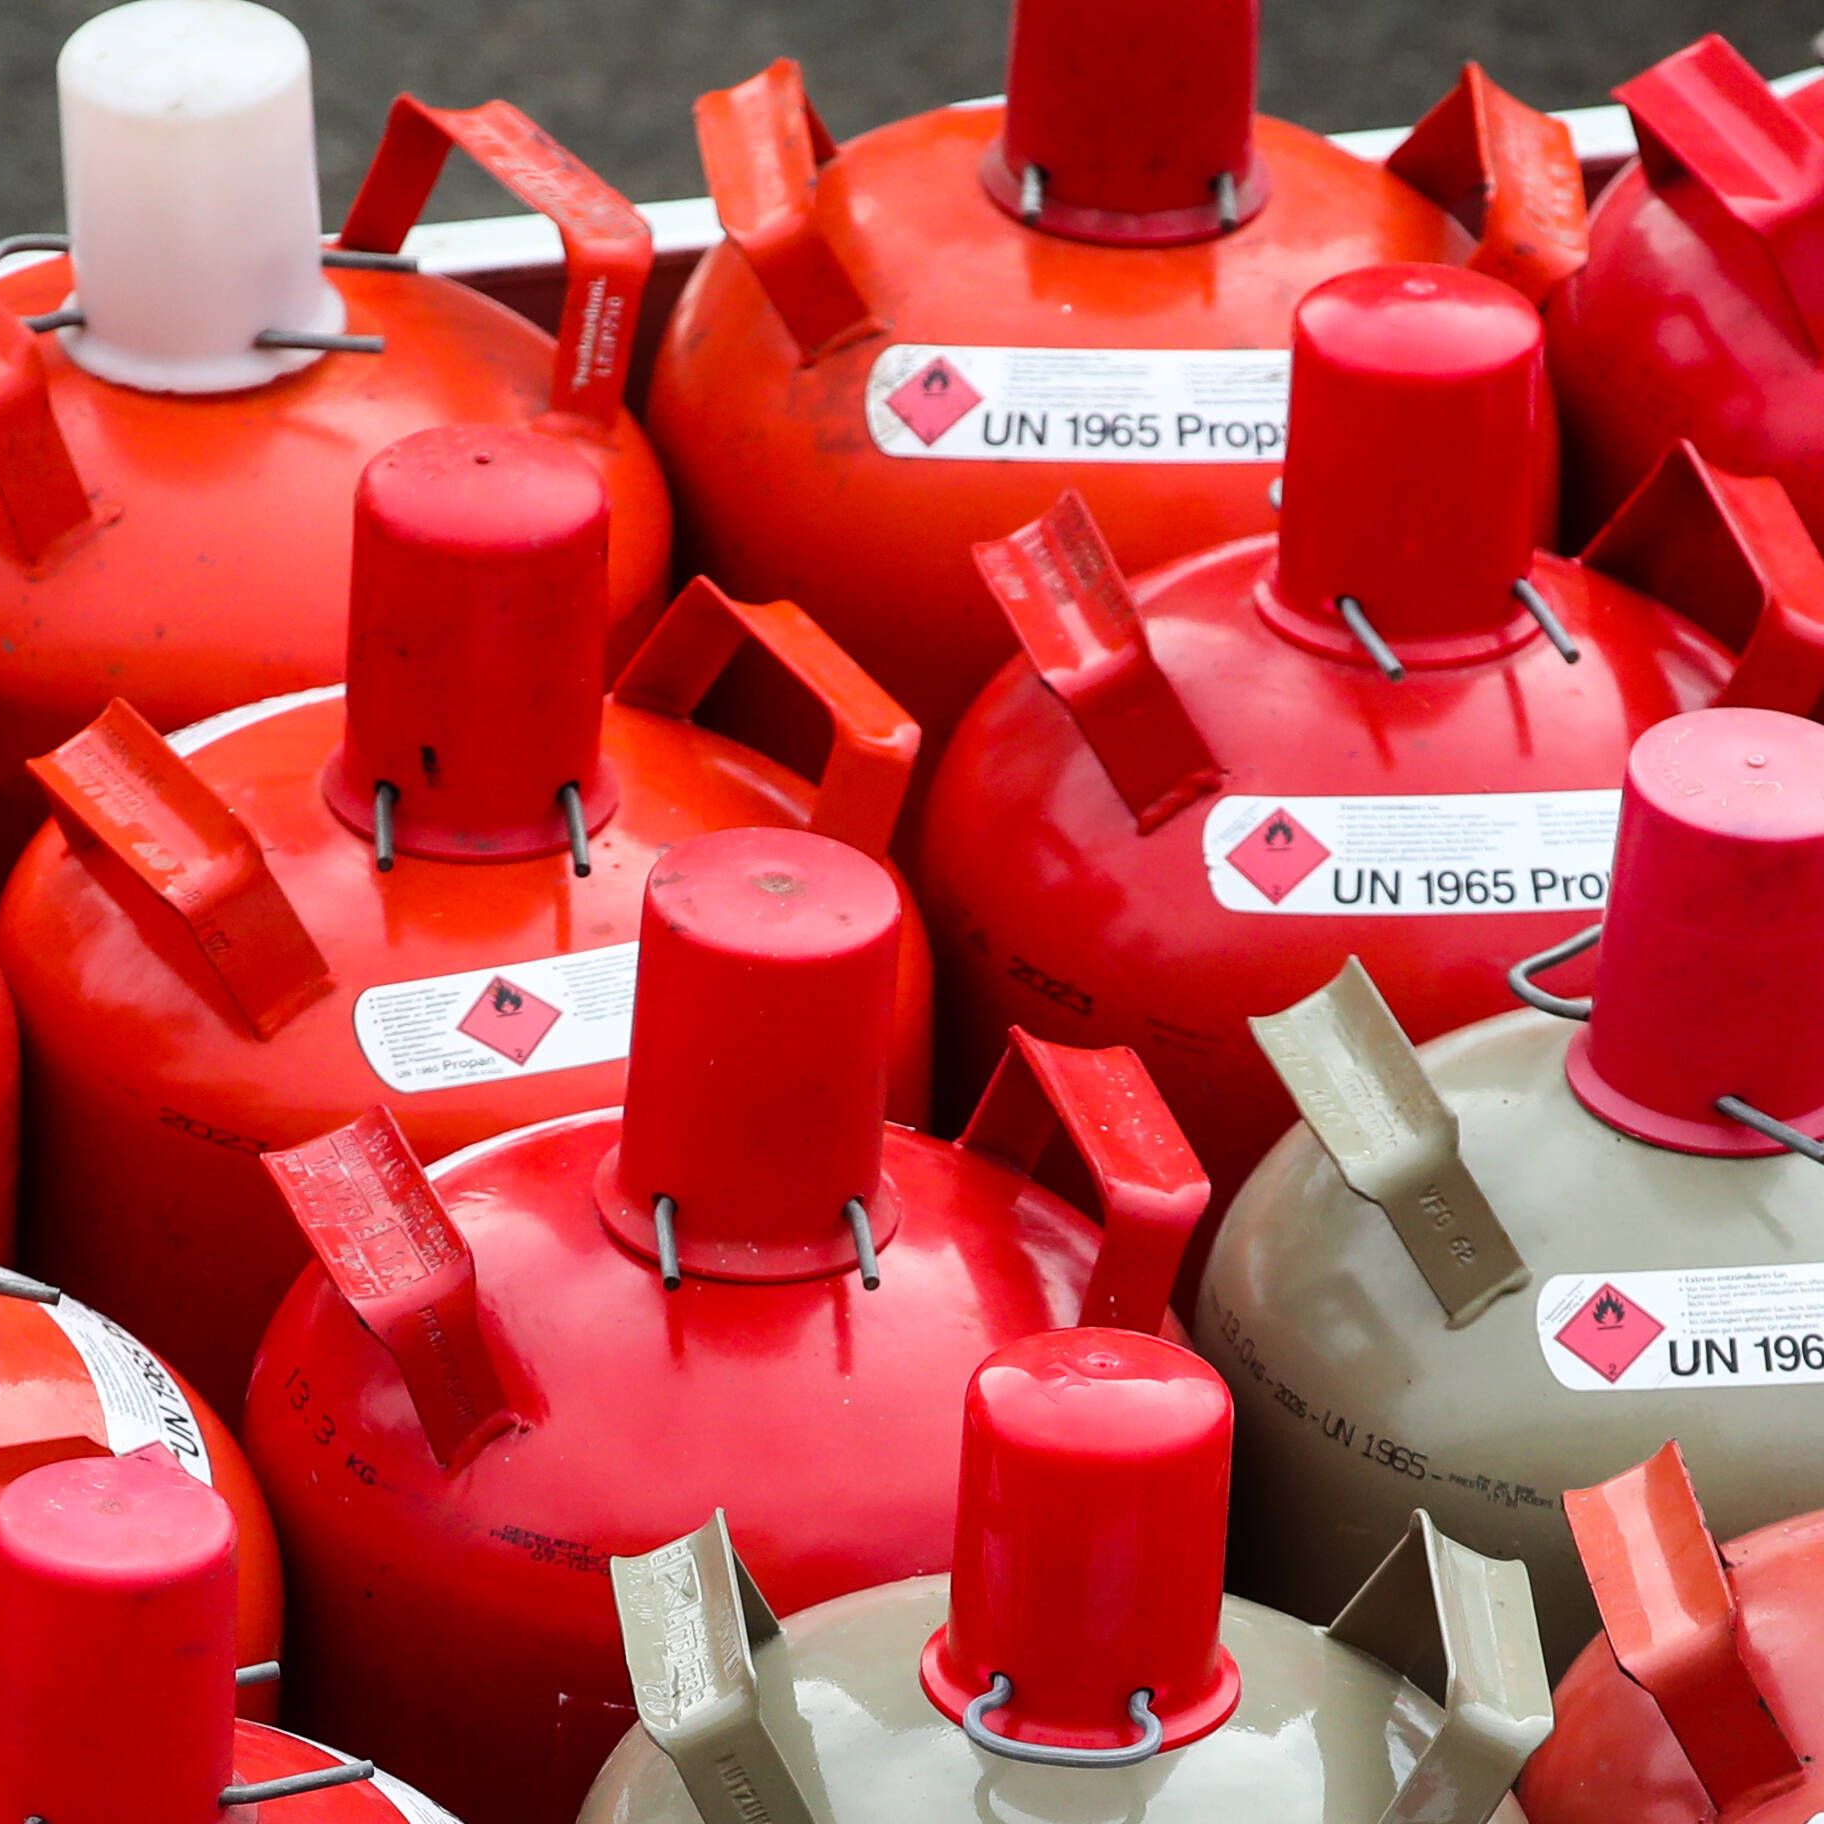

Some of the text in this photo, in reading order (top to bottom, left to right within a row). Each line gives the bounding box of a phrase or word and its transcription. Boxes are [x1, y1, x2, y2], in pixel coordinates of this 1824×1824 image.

[982, 413, 1289, 456] UN 1965 Prop
[1332, 866, 1610, 907] UN 1965 Pro
[441, 1054, 497, 1074] Propan
[1667, 1337, 1739, 1378] UN
[158, 1405, 200, 1460] UN
[283, 1368, 376, 1485] 13.3 KG
[1272, 1380, 1429, 1481] 2026 UN 1965
